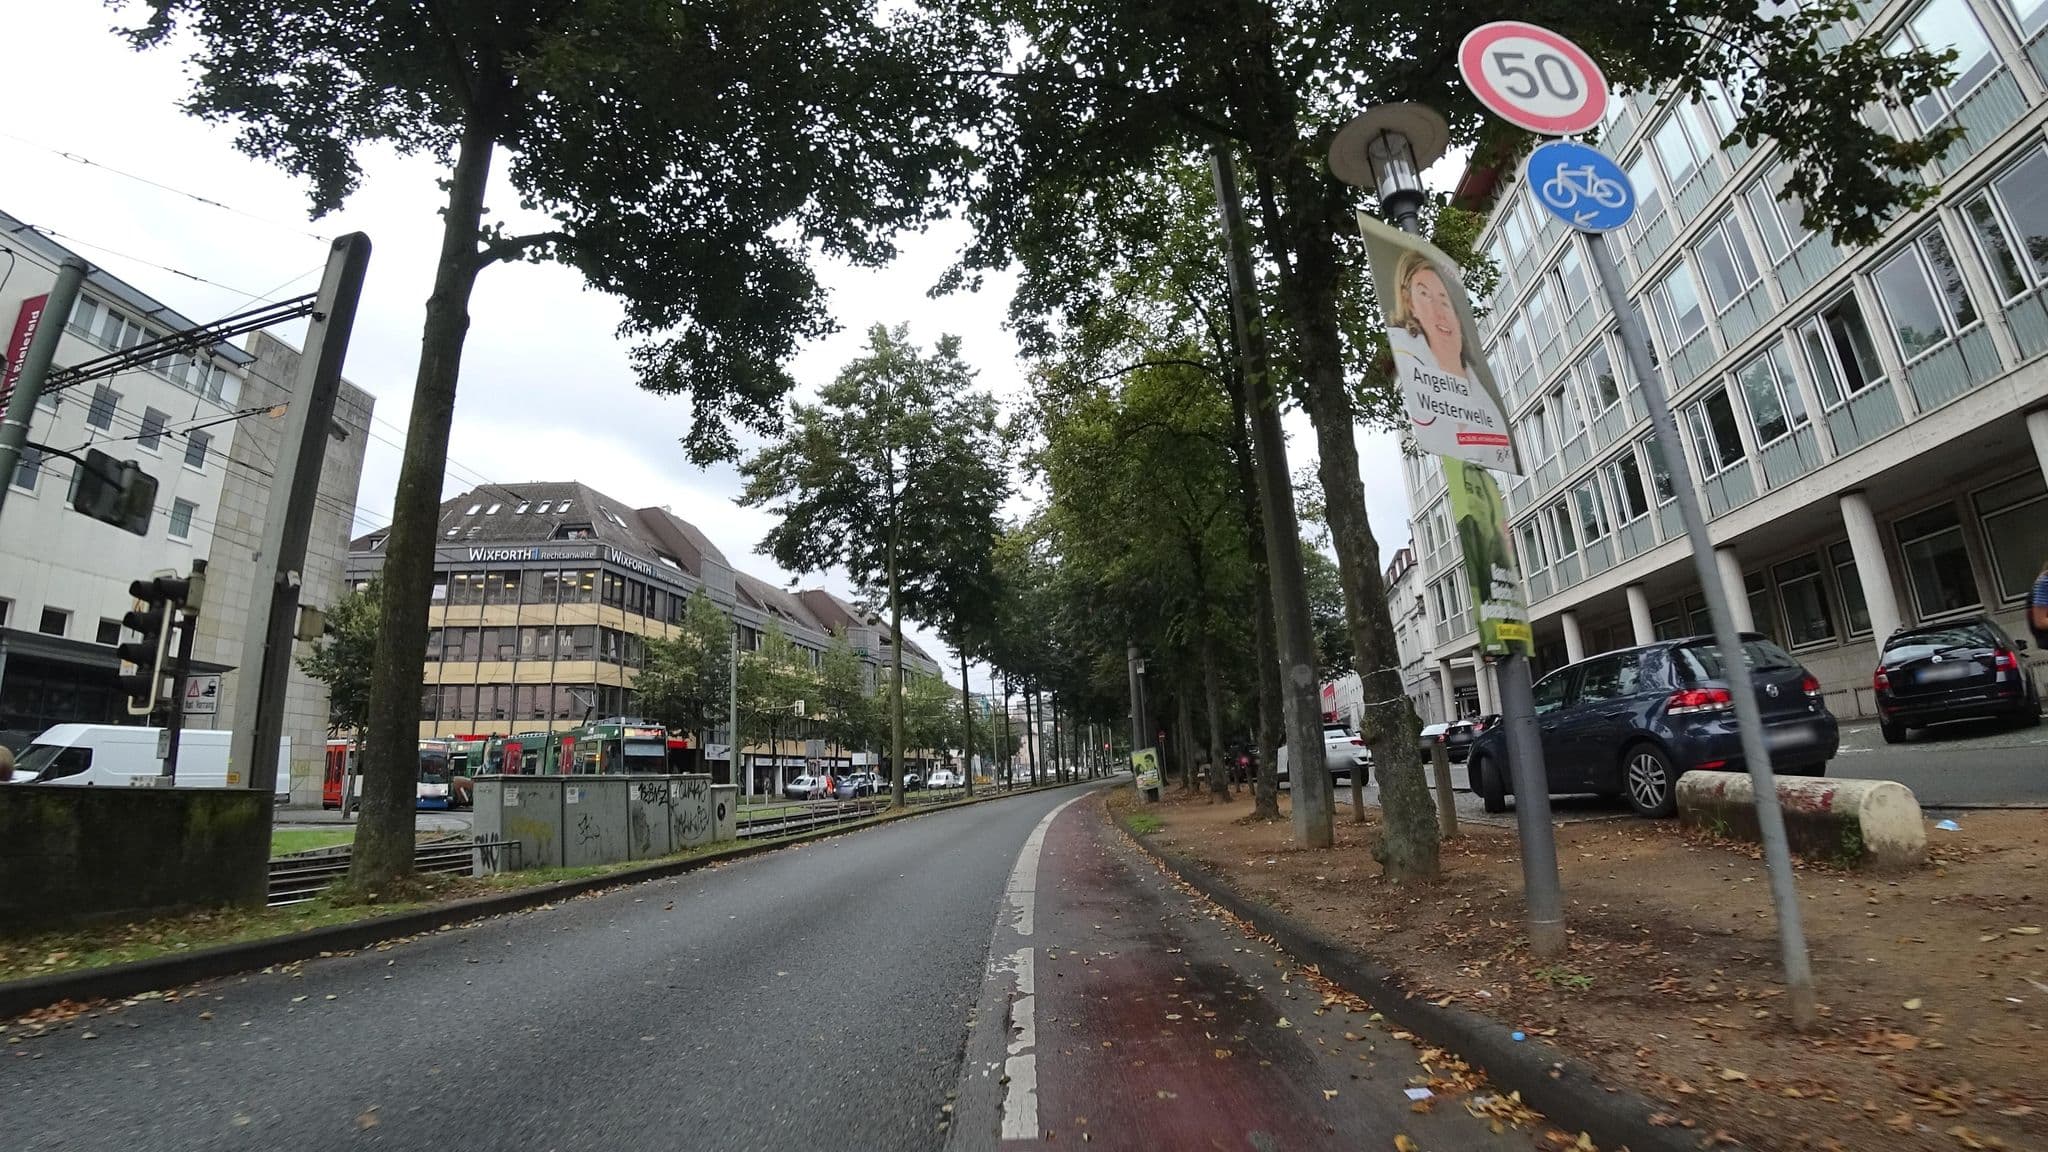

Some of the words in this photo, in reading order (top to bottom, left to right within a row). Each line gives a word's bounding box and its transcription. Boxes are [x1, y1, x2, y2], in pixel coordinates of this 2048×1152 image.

[1493, 51, 1579, 101] 50
[13, 310, 40, 374] Bielefeld
[1413, 367, 1469, 397] Angelika
[1416, 392, 1494, 428] Westerwelle
[541, 551, 595, 560] Rechtsanwälte
